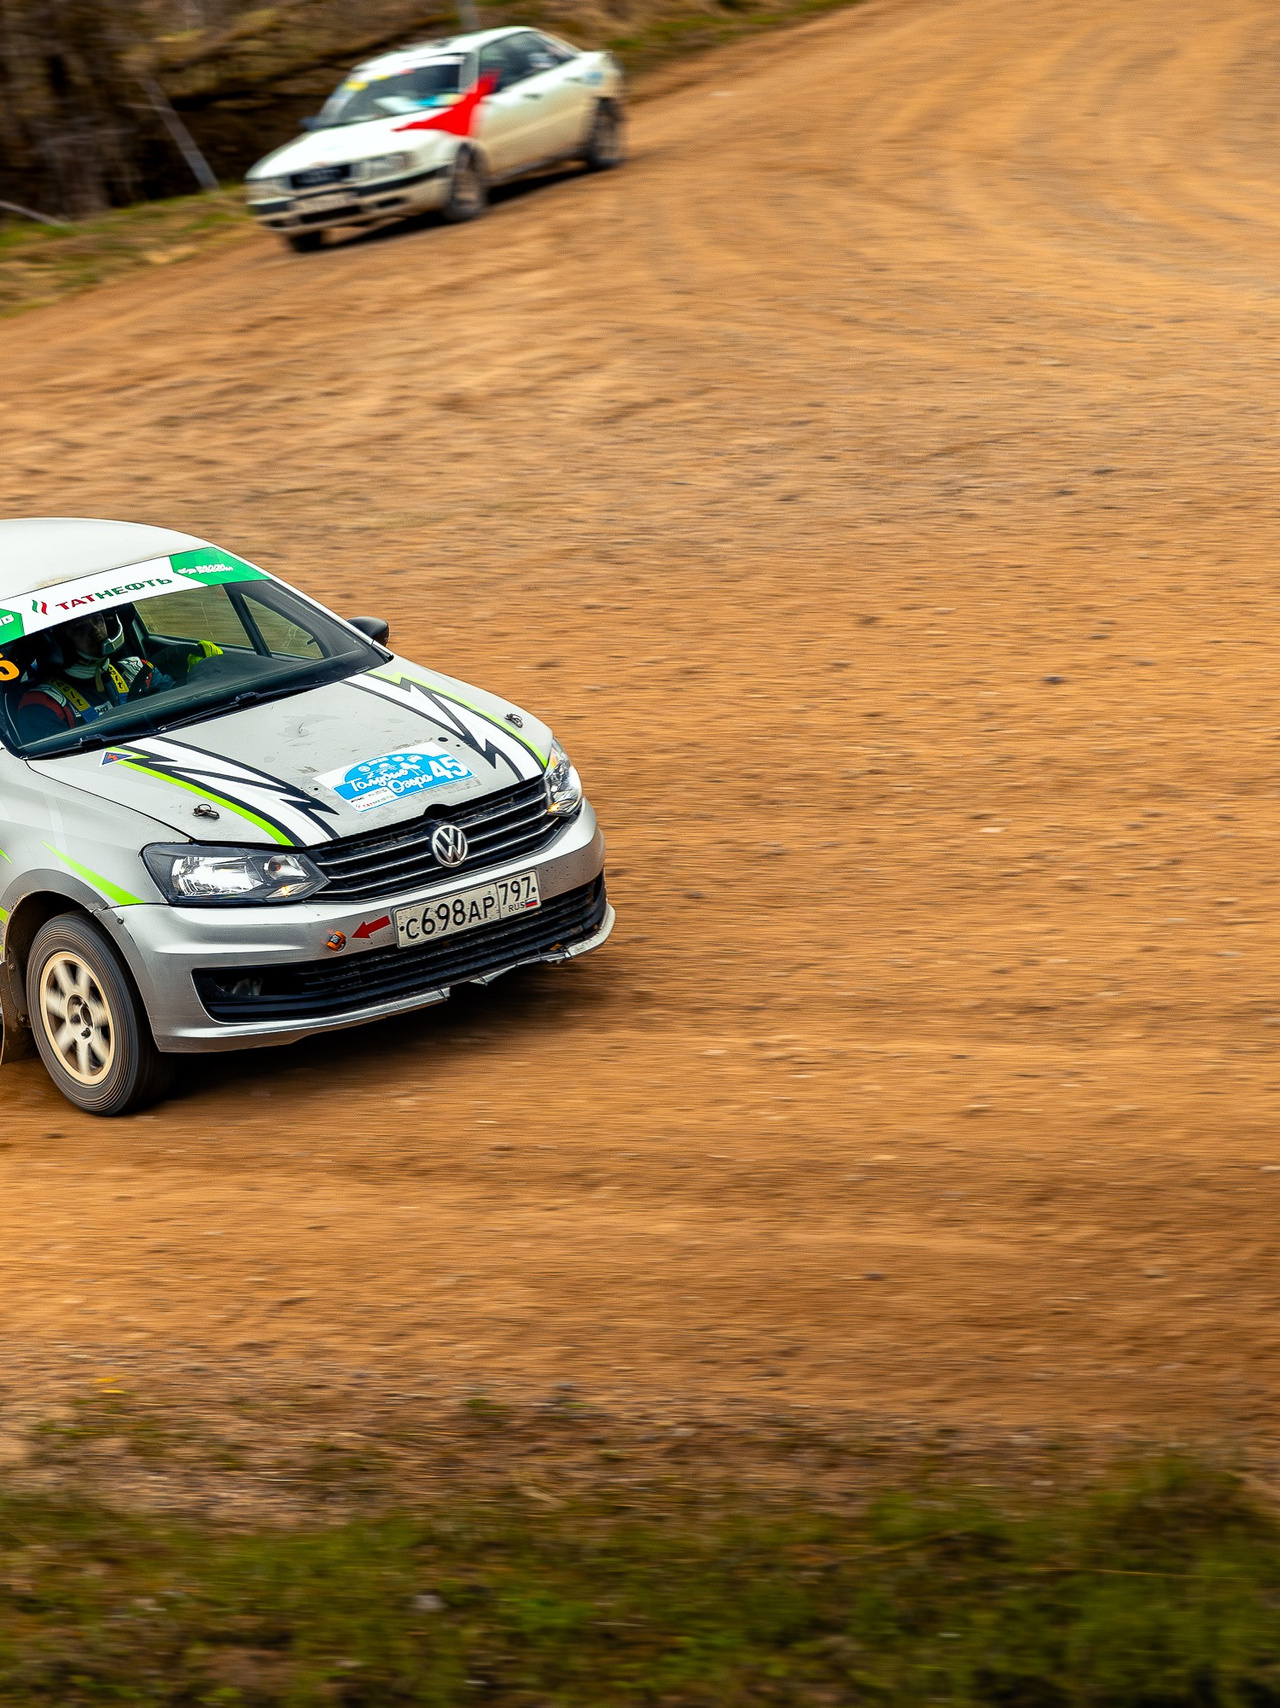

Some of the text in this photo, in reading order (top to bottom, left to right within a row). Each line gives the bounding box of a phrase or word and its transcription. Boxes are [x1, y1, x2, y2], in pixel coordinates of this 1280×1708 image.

[55, 578, 173, 611] ТАТНЕФТЬ
[429, 754, 469, 779] 45
[405, 875, 531, 939] С698АР 797
[508, 902, 525, 912] RUS
